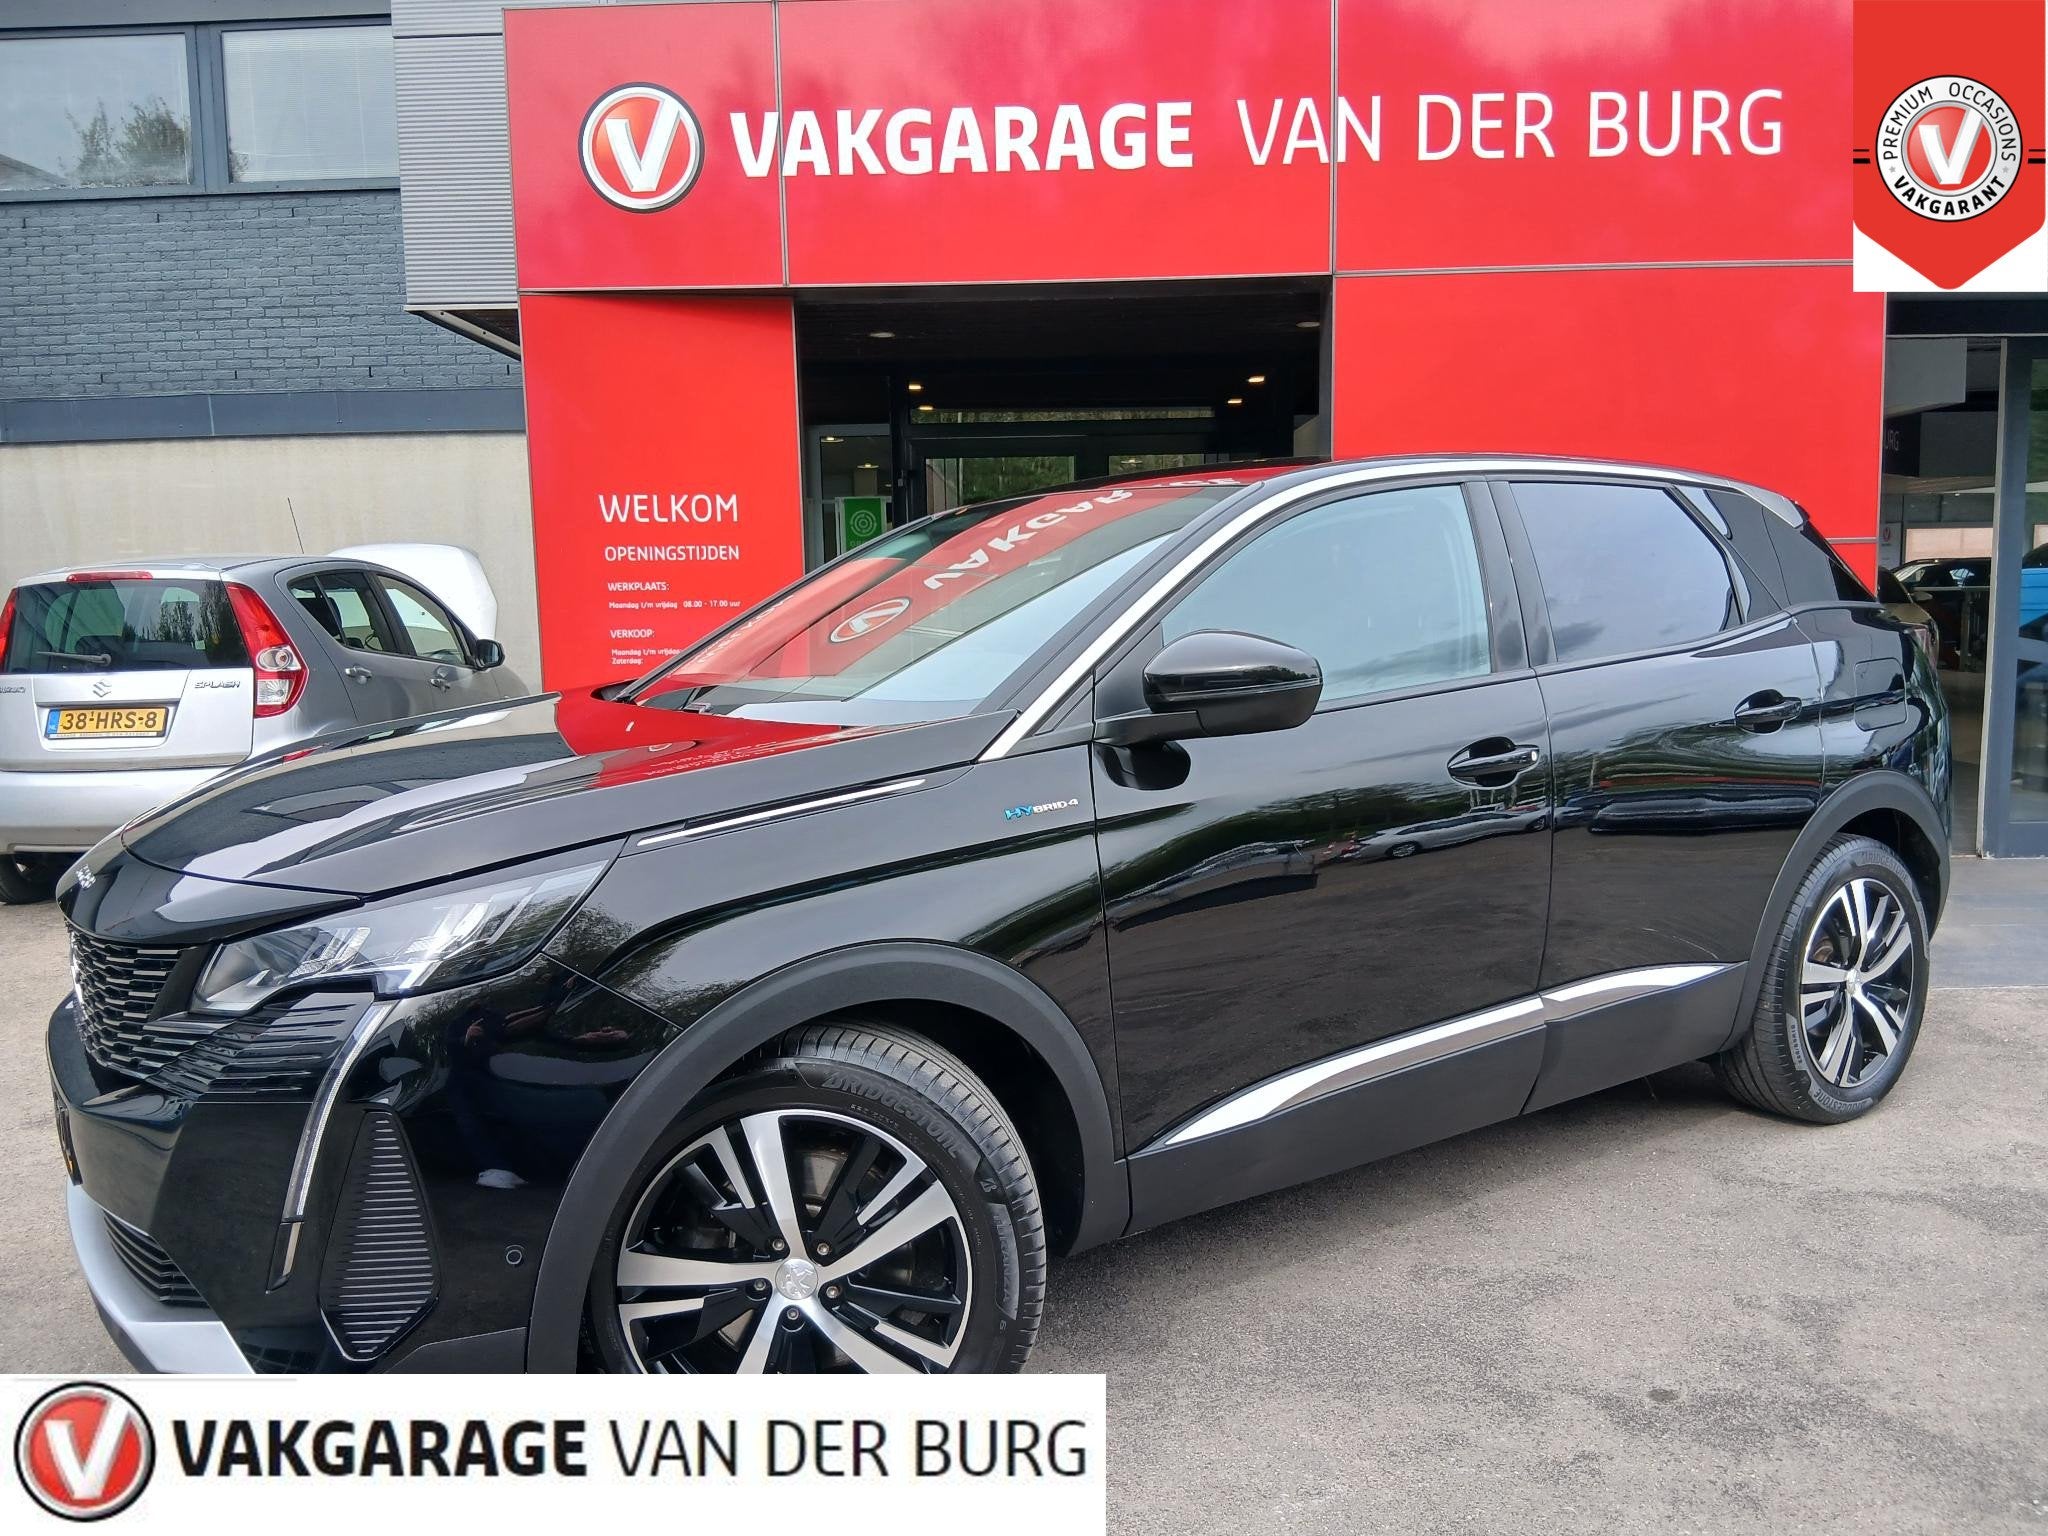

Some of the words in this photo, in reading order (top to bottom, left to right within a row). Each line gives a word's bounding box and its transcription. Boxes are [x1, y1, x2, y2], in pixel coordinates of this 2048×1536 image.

[729, 101, 1194, 178] VAKGARAGE
[1237, 95, 1382, 166] VAN
[1417, 92, 1555, 161] DER
[1588, 88, 1784, 157] BURG
[598, 493, 738, 523] WELKOM
[604, 545, 740, 562] OPENINGSTIJDEN
[607, 581, 670, 592] WERKPLAATS:
[608, 601, 640, 610] Maandag
[655, 600, 678, 610] vrijdag
[729, 600, 741, 608] uur
[610, 628, 655, 639] VERKOOP:
[611, 648, 642, 657] Maandag
[62, 710, 158, 730] 38-HRS-8
